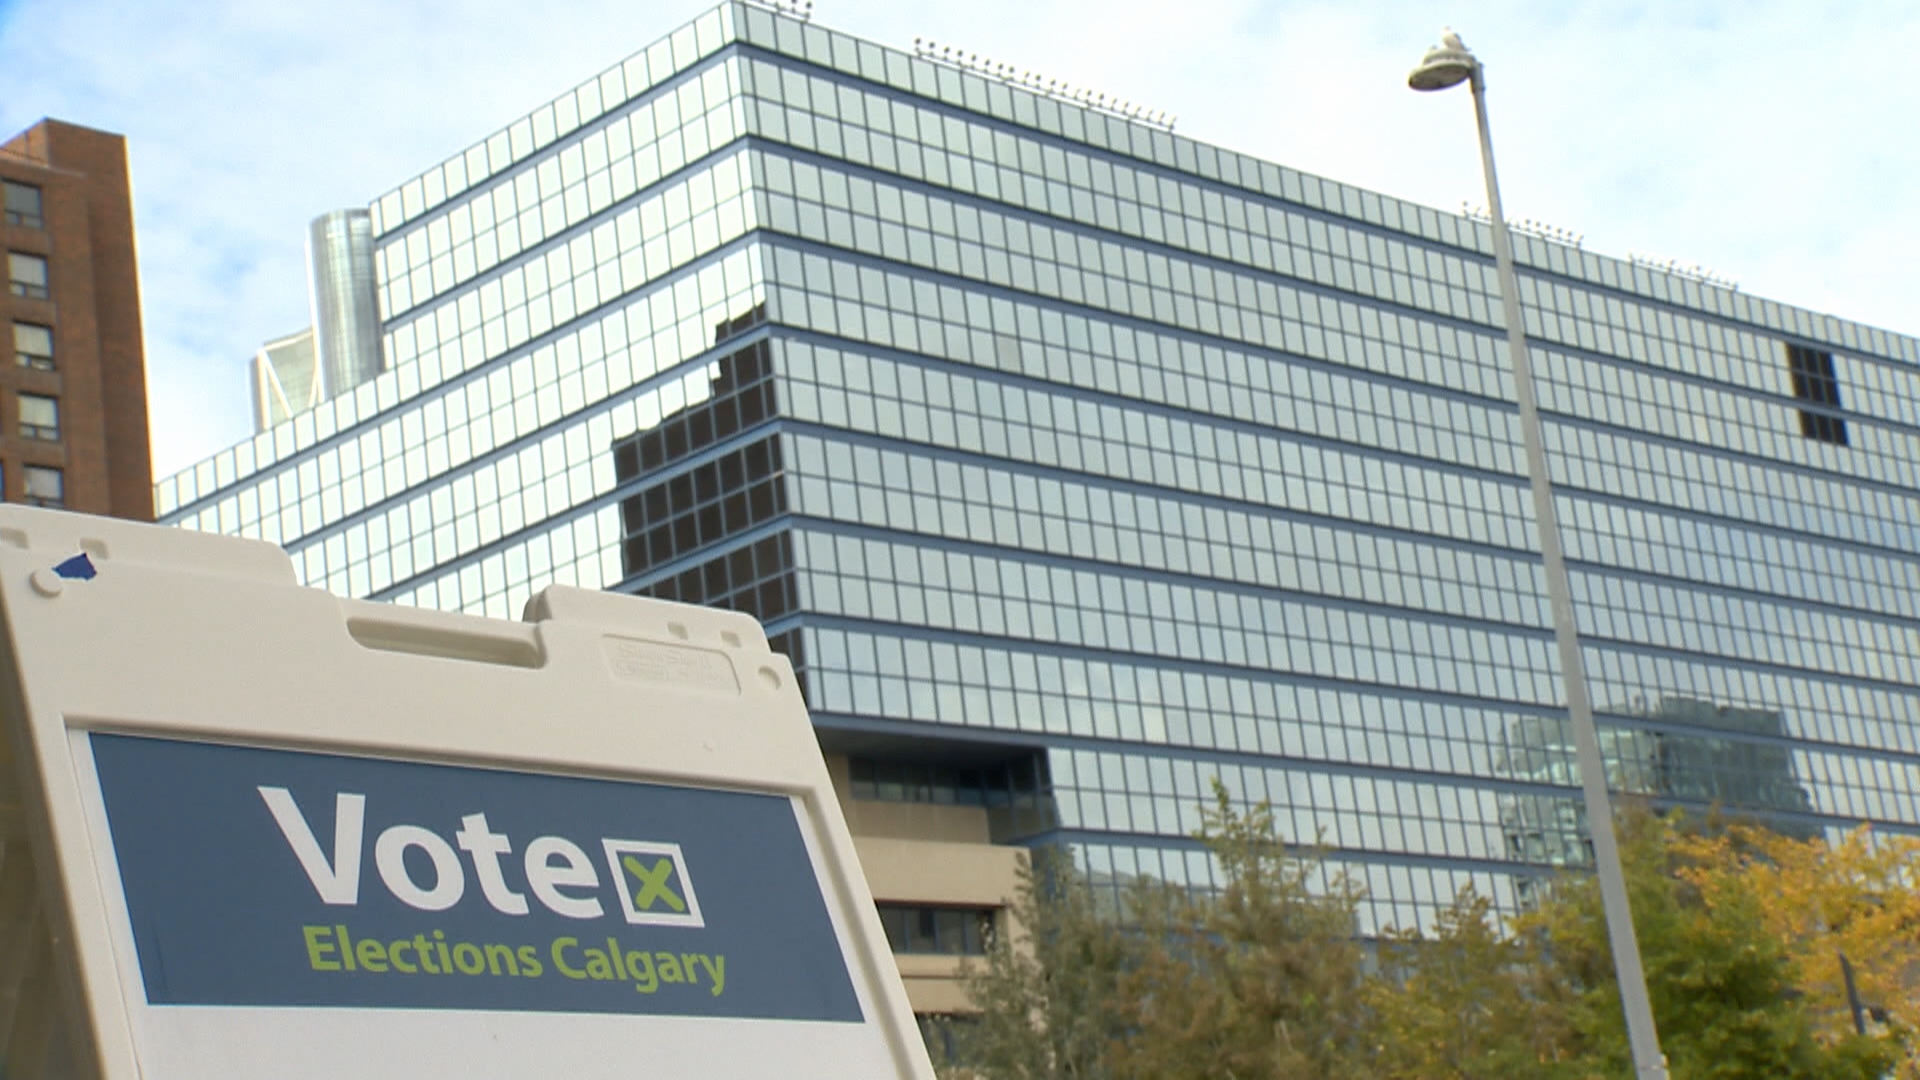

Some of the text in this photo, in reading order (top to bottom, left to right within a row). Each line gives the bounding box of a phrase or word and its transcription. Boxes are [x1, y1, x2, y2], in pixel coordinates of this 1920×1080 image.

[256, 786, 605, 919] Vote
[302, 925, 726, 997] Elections Calgary
